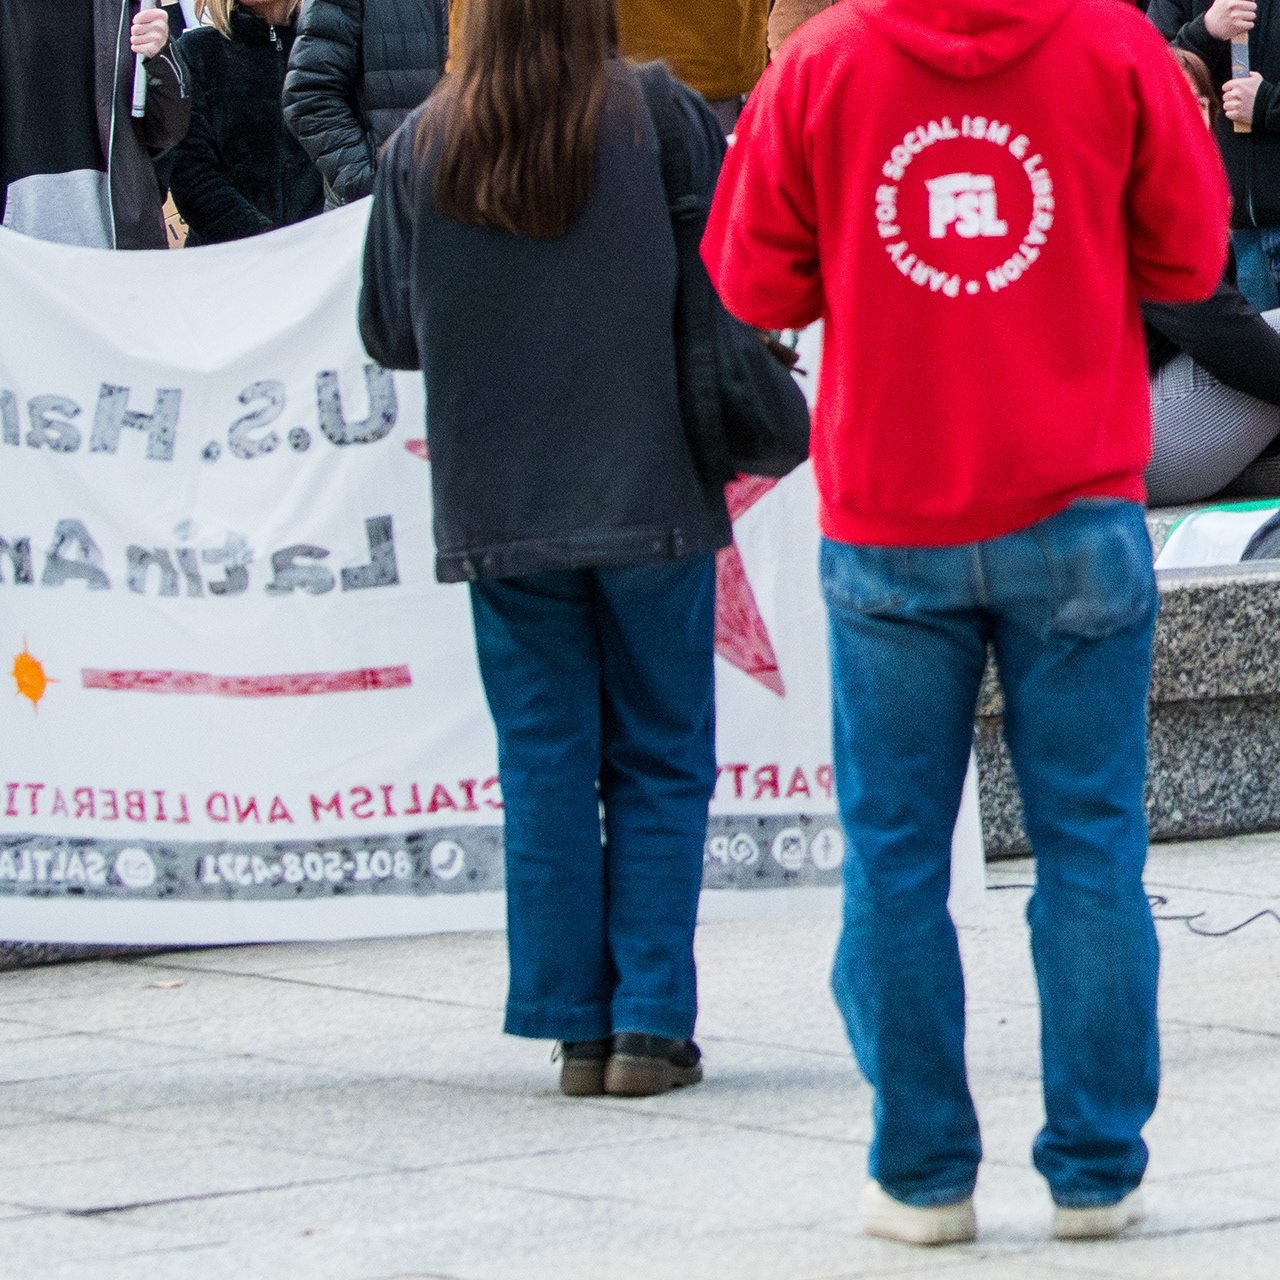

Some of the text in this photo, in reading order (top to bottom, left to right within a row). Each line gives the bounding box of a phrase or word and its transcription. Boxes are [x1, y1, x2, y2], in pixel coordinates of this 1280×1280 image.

[882, 114, 1012, 181] SOCIALISM
[875, 184, 901, 239] FOR
[928, 191, 1009, 239] PSL
[886, 240, 961, 298] PARTY
